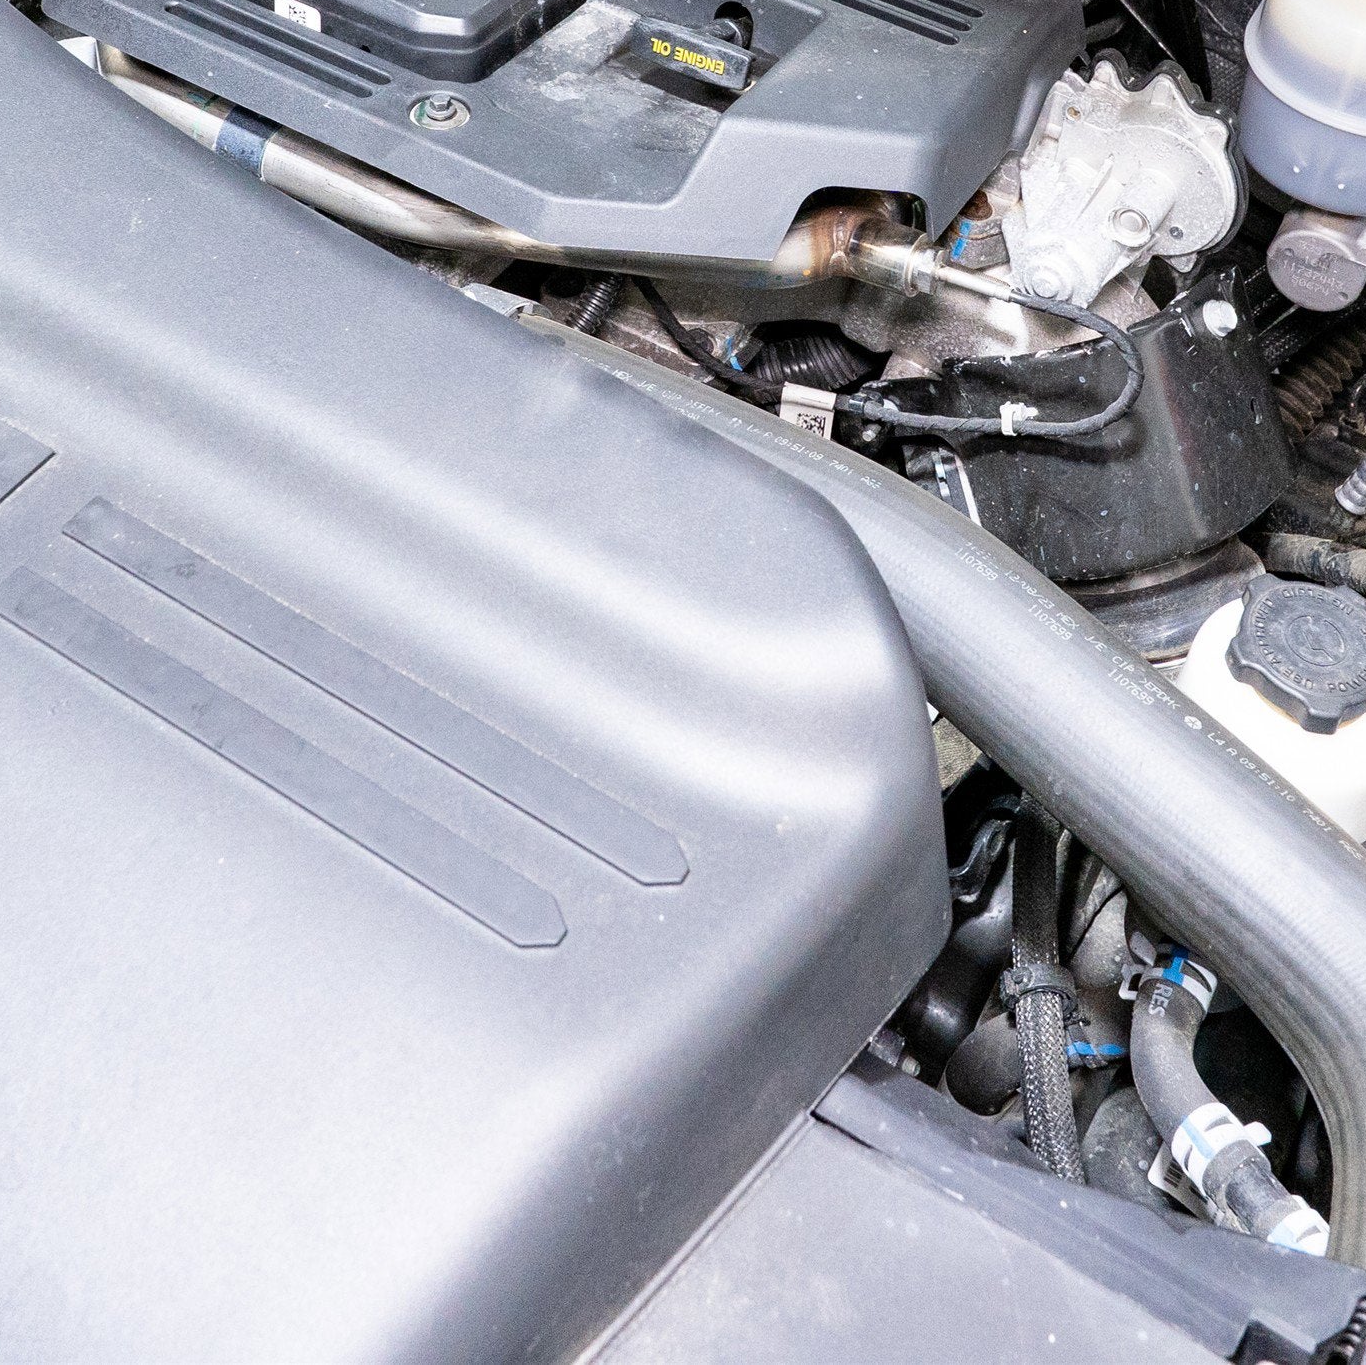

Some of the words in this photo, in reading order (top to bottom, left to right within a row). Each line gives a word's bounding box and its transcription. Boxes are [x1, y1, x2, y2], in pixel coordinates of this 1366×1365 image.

[650, 37, 672, 57] OIL
[674, 46, 725, 76] ENGINE
[955, 547, 998, 581] 1107699
[1028, 604, 1073, 641] 1107699
[1108, 668, 1155, 706] 1107699
[1239, 757, 1296, 802] 09:51:10
[1148, 983, 1173, 1017] RES
